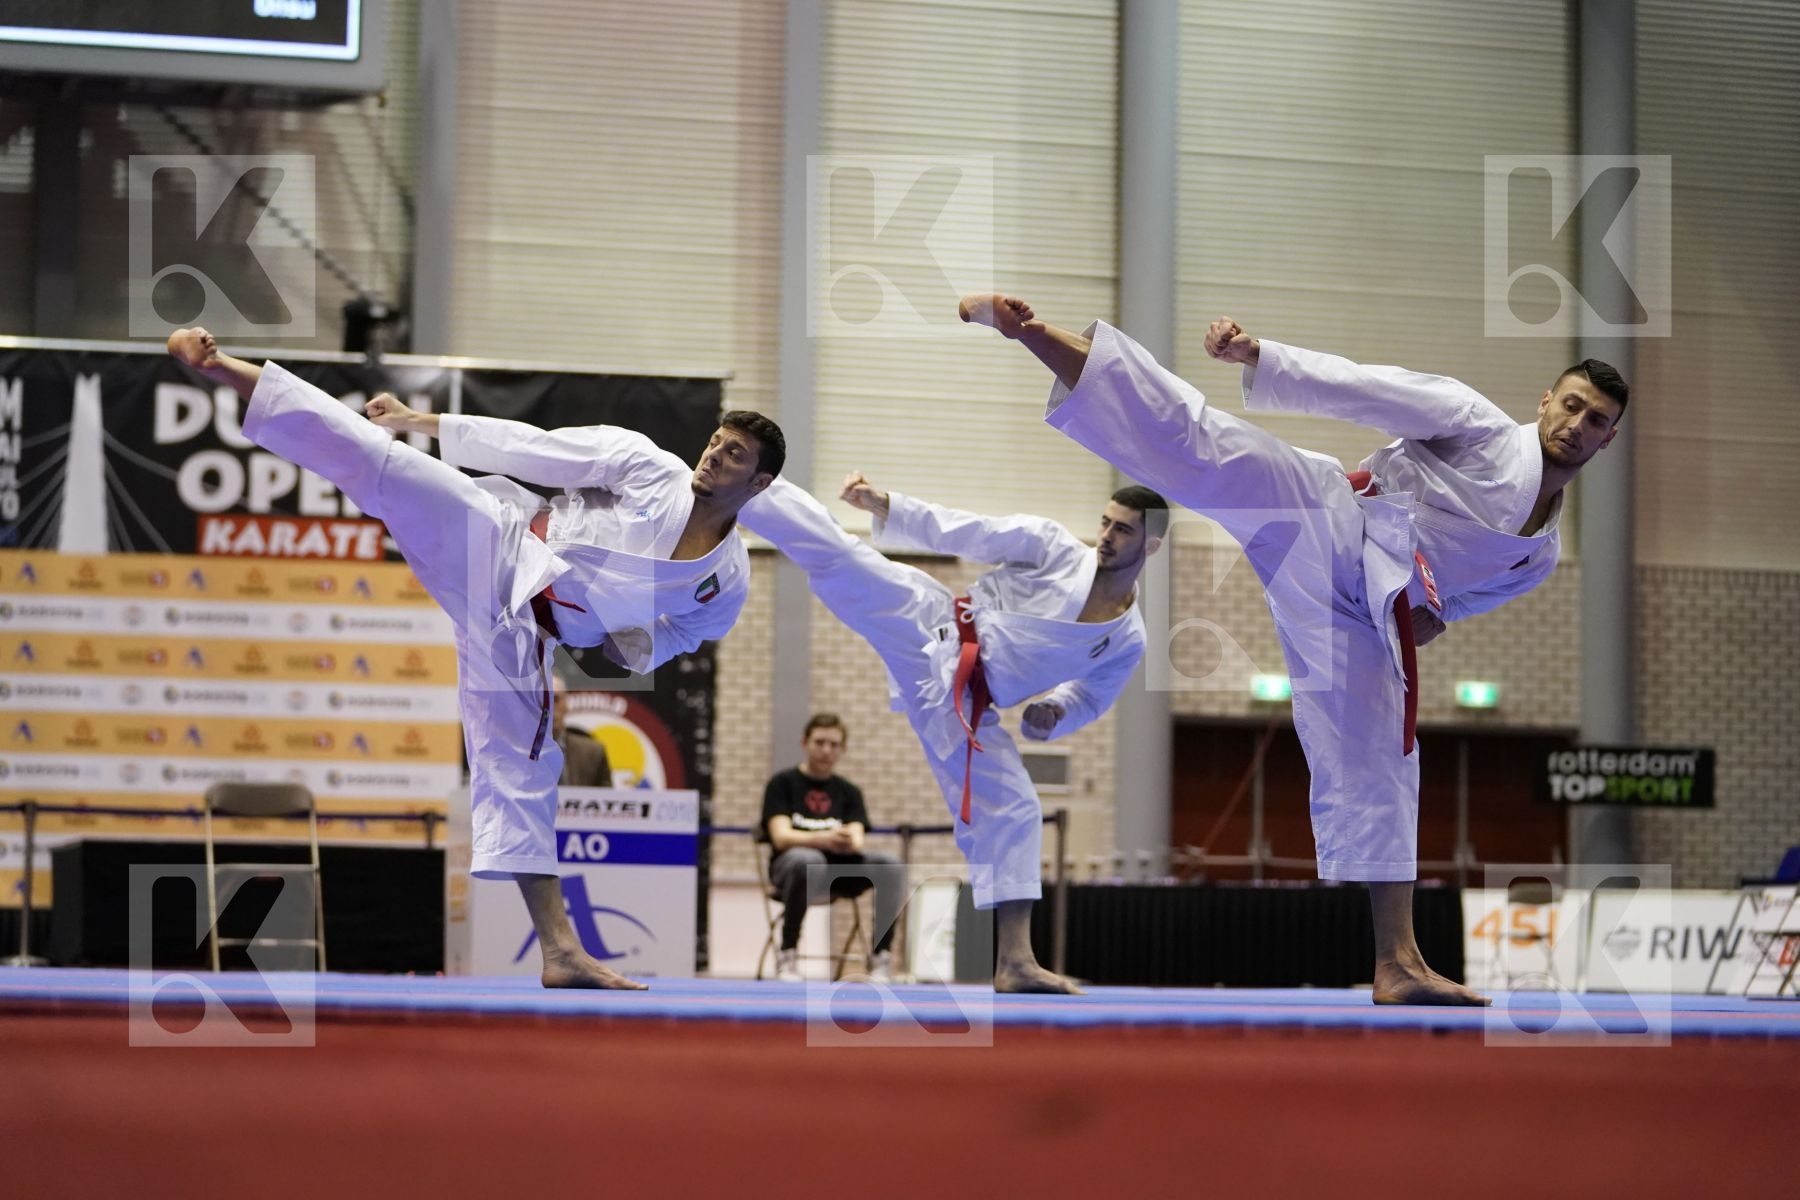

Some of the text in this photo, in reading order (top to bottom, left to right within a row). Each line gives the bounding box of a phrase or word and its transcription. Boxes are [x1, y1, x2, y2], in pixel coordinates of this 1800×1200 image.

[177, 450, 363, 520] OPE
[1548, 750, 1696, 776] rotterdam
[1548, 774, 1693, 801] TOPSPORT
[562, 832, 610, 861] AO
